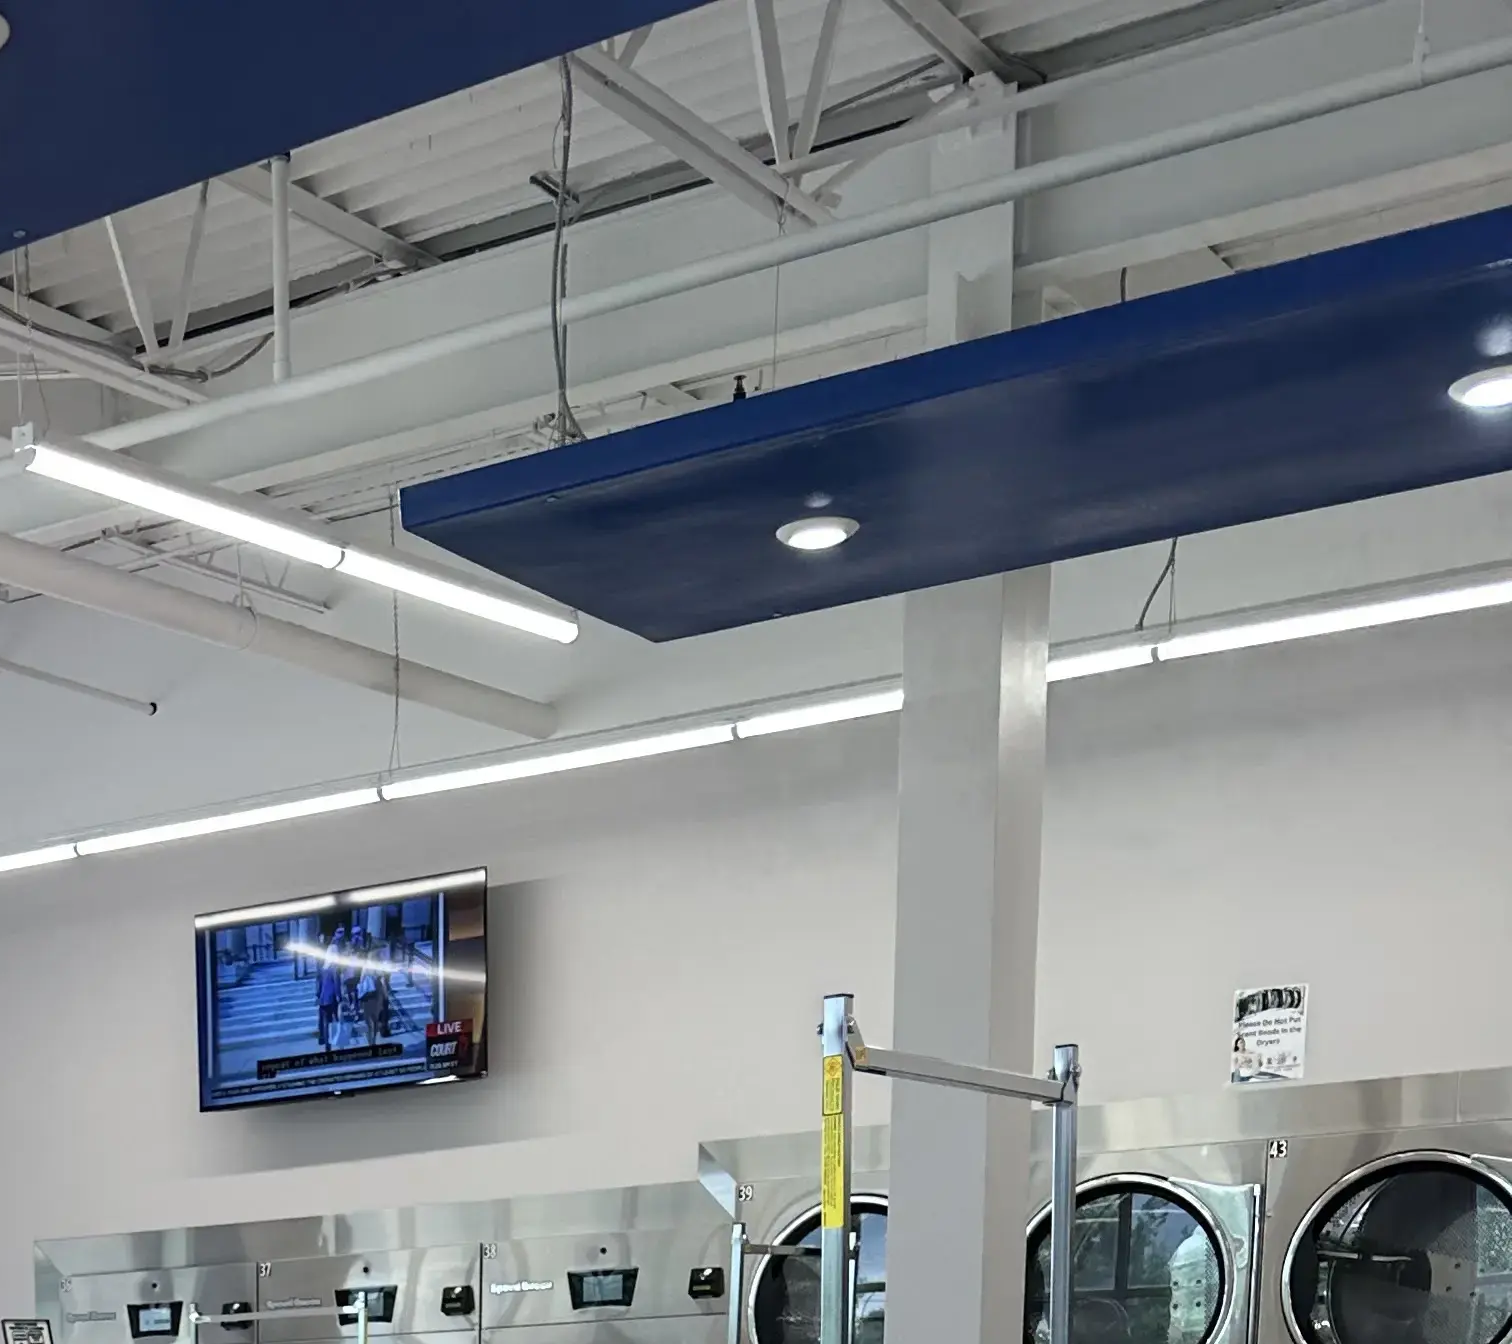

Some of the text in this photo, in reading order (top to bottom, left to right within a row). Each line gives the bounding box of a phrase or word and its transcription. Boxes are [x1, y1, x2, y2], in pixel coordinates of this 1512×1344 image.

[437, 1021, 462, 1035] LIVE
[1269, 1140, 1287, 1158] 43
[739, 1185, 753, 1201] 39
[484, 1243, 496, 1258] 38
[260, 1263, 271, 1277] 37
